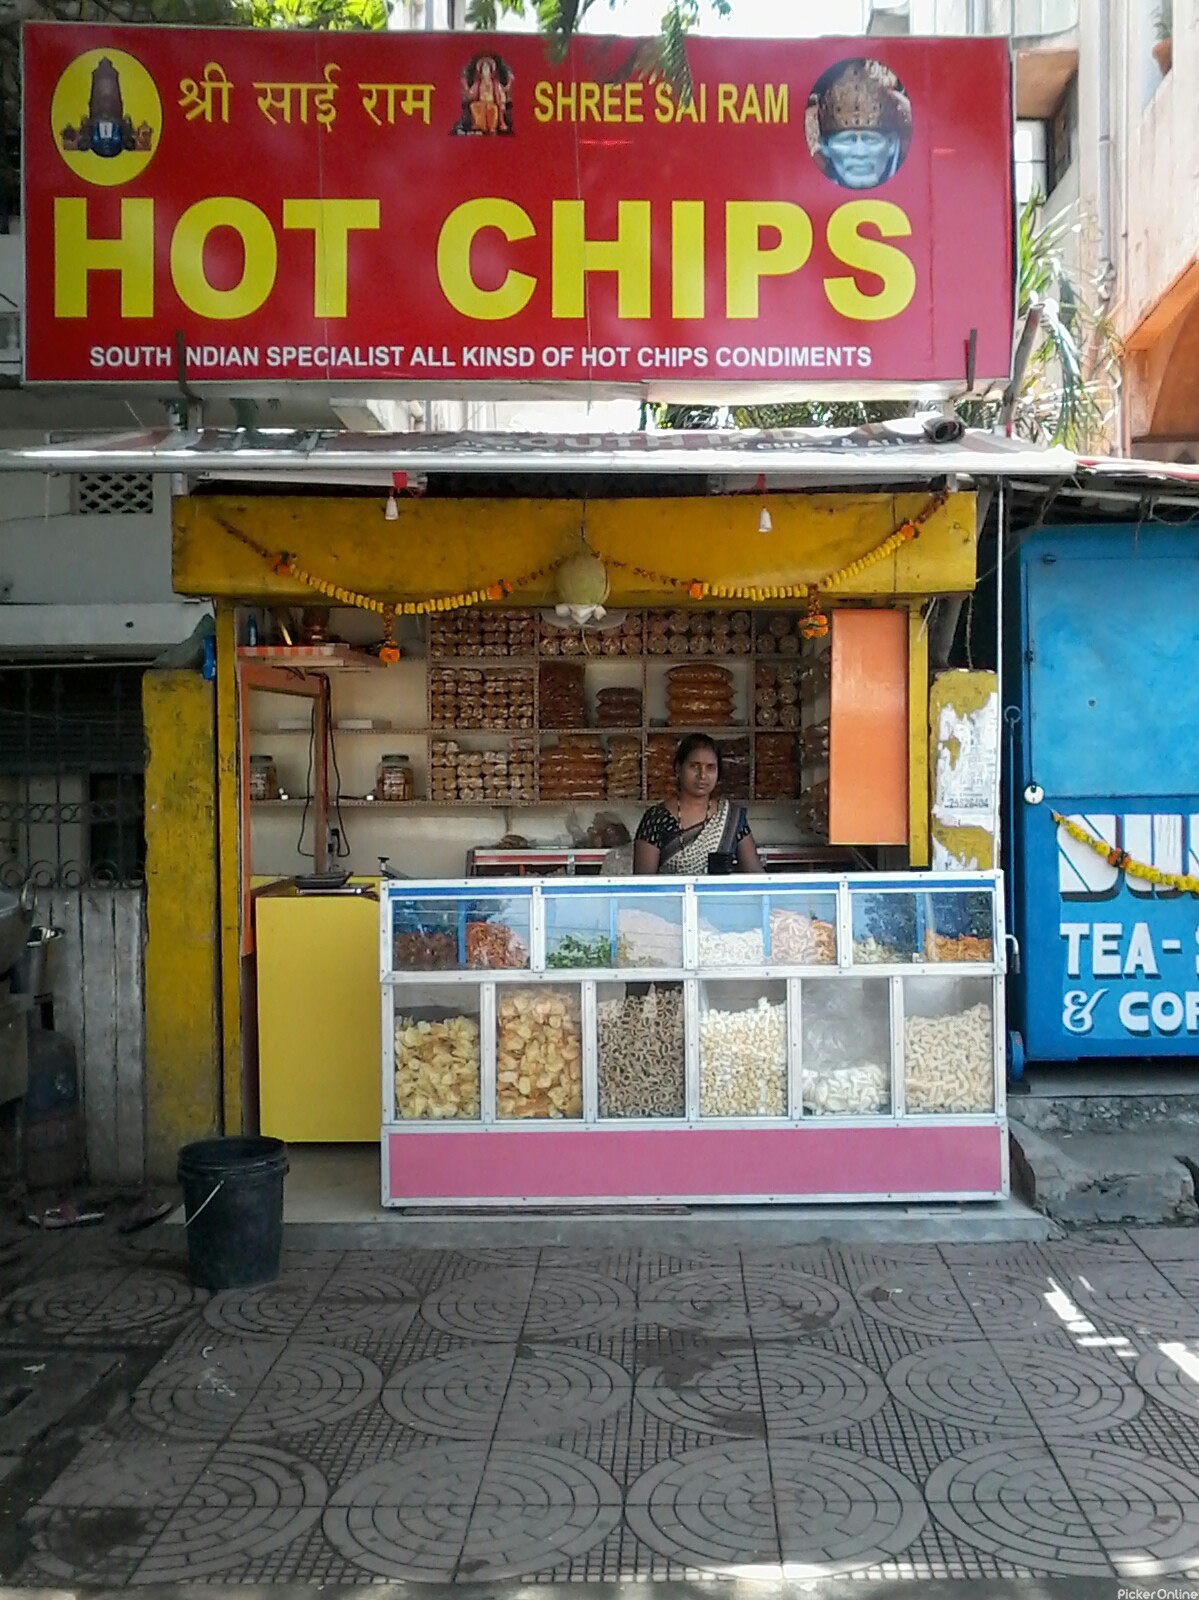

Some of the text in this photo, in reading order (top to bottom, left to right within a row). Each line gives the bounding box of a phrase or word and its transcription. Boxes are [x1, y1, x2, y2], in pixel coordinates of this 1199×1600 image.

[178, 61, 436, 132] श्री साई राम
[534, 80, 789, 124] SHREE SAI RAM
[53, 196, 916, 321] HOT CHIPS
[90, 346, 872, 368] SOUTH NDIAN SPECIALIST ALL KINSD OF HOT CHIPS CONDIMENTS
[1062, 988, 1110, 1033] &
